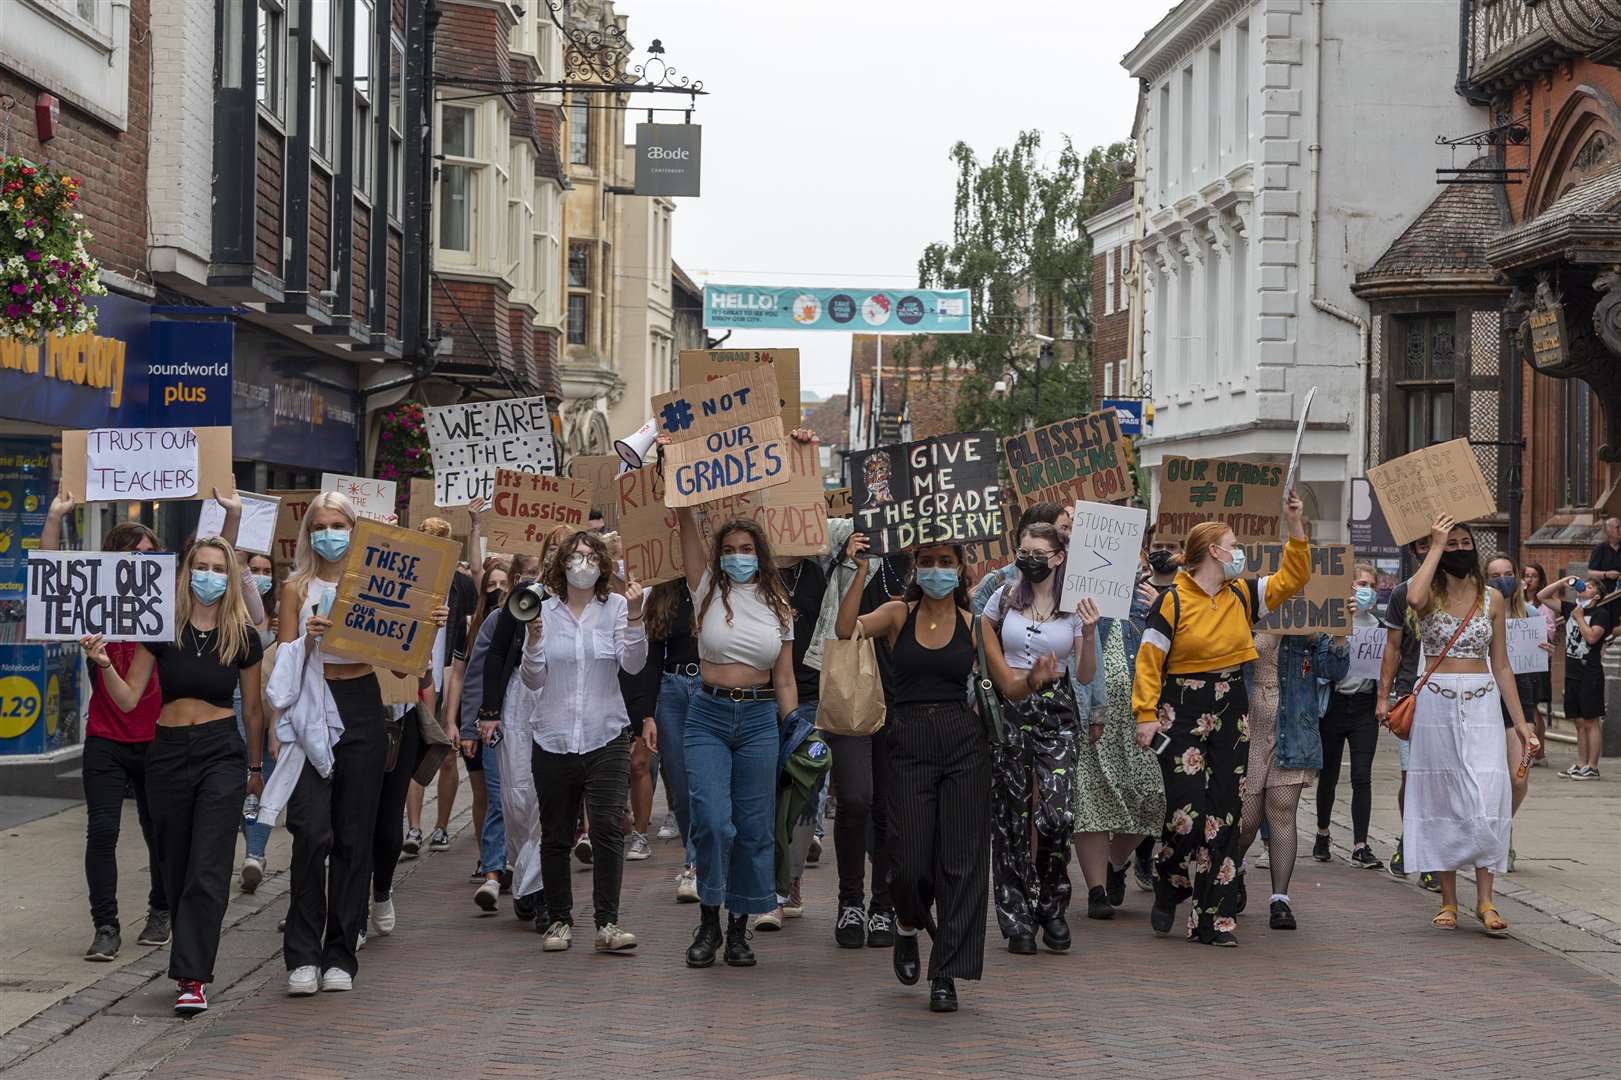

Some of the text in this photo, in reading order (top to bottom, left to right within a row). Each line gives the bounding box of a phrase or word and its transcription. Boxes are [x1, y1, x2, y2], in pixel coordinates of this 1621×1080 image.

[711, 292, 778, 310] HELLO!
[164, 382, 207, 406] plus
[440, 402, 546, 440] WE ARE
[91, 430, 197, 454] TRUST OUR
[467, 440, 518, 465] THE
[706, 425, 754, 453] OUR
[911, 438, 981, 469] GIVE
[1005, 410, 1119, 470] CLASSIST
[93, 467, 196, 493] TEACHERS
[496, 469, 523, 489] It's
[530, 474, 560, 494] the
[675, 443, 782, 496] GRADES
[913, 468, 955, 497] ME
[1016, 442, 1119, 495] GRADING
[1092, 465, 1126, 498] GO!
[1168, 458, 1283, 487] OUR GRADES
[351, 496, 369, 508] THE
[493, 491, 583, 526] Classism
[858, 485, 999, 529] THE GRADE
[1223, 483, 1244, 507] A
[882, 511, 1002, 553] I DESERVE
[1076, 511, 1139, 537] STUDENTS
[1084, 534, 1121, 552] LIVES
[364, 546, 421, 576] THESE
[1236, 543, 1346, 576] UTME
[28, 558, 162, 598] TRUST OUR
[367, 575, 413, 601] NOT
[1065, 574, 1132, 600] STATISTICS
[41, 594, 164, 637] TEACHERS
[352, 603, 376, 617] OUR
[344, 612, 419, 651] GRADES!
[1520, 628, 1539, 641] THE
